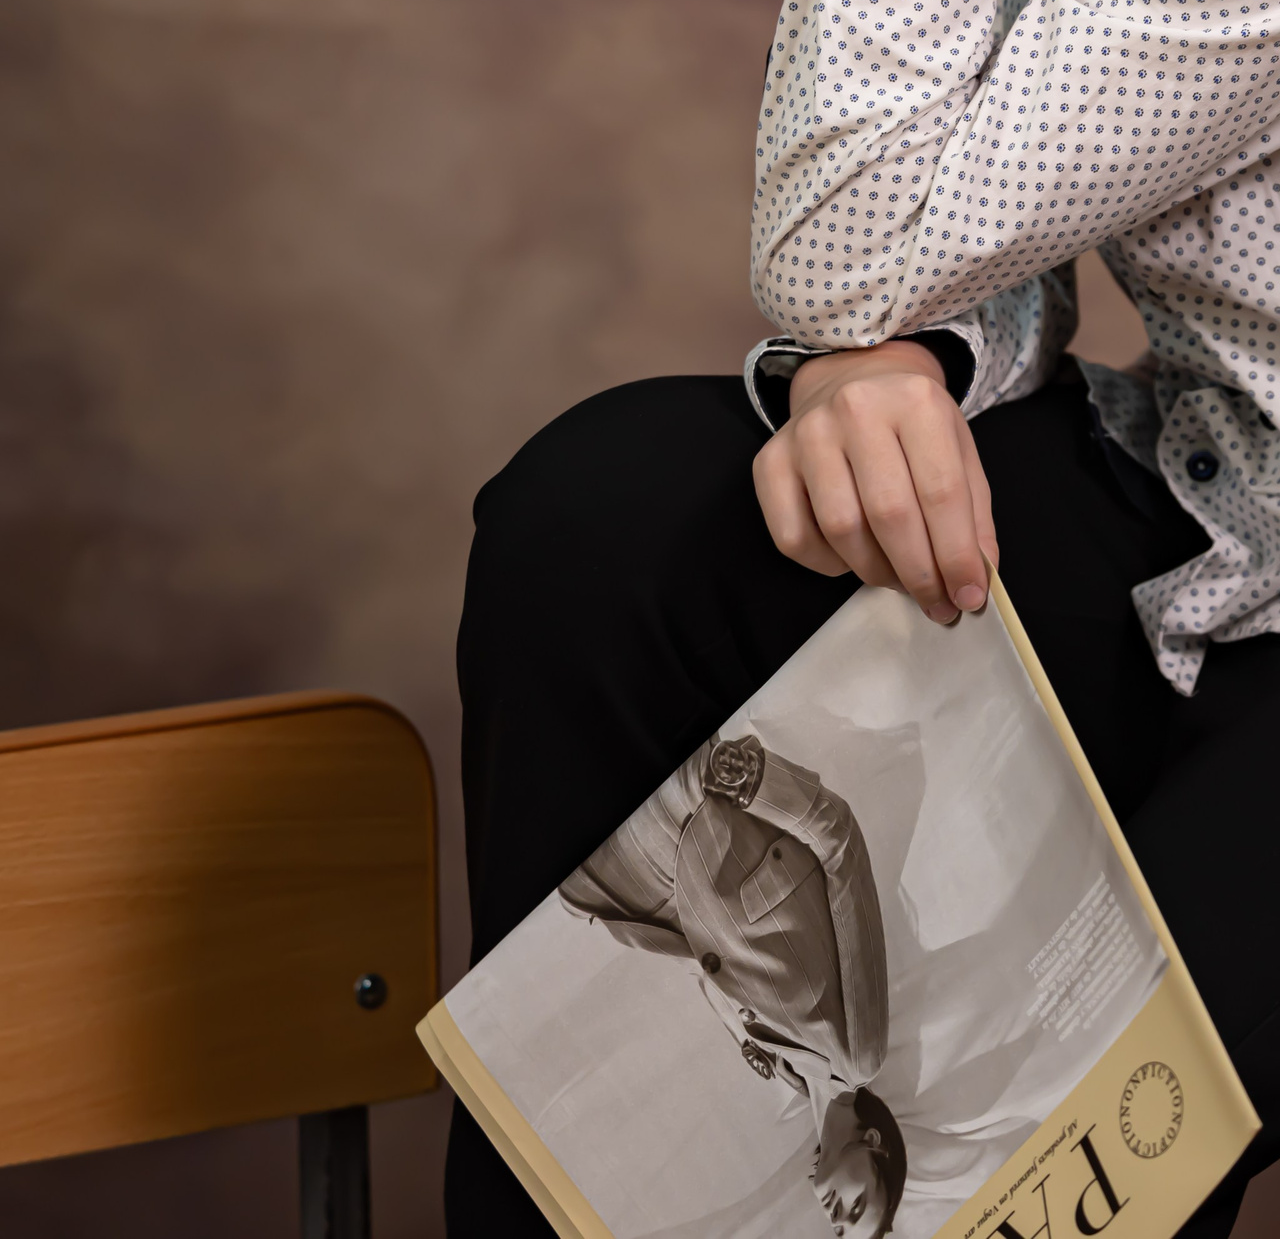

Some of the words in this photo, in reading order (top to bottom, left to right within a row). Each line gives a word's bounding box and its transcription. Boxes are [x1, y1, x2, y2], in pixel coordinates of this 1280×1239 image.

[1038, 1125, 1068, 1165] products
[1009, 1156, 1038, 1196] featured
[998, 1193, 1009, 1206] on
[976, 1205, 1000, 1230] Vogue
